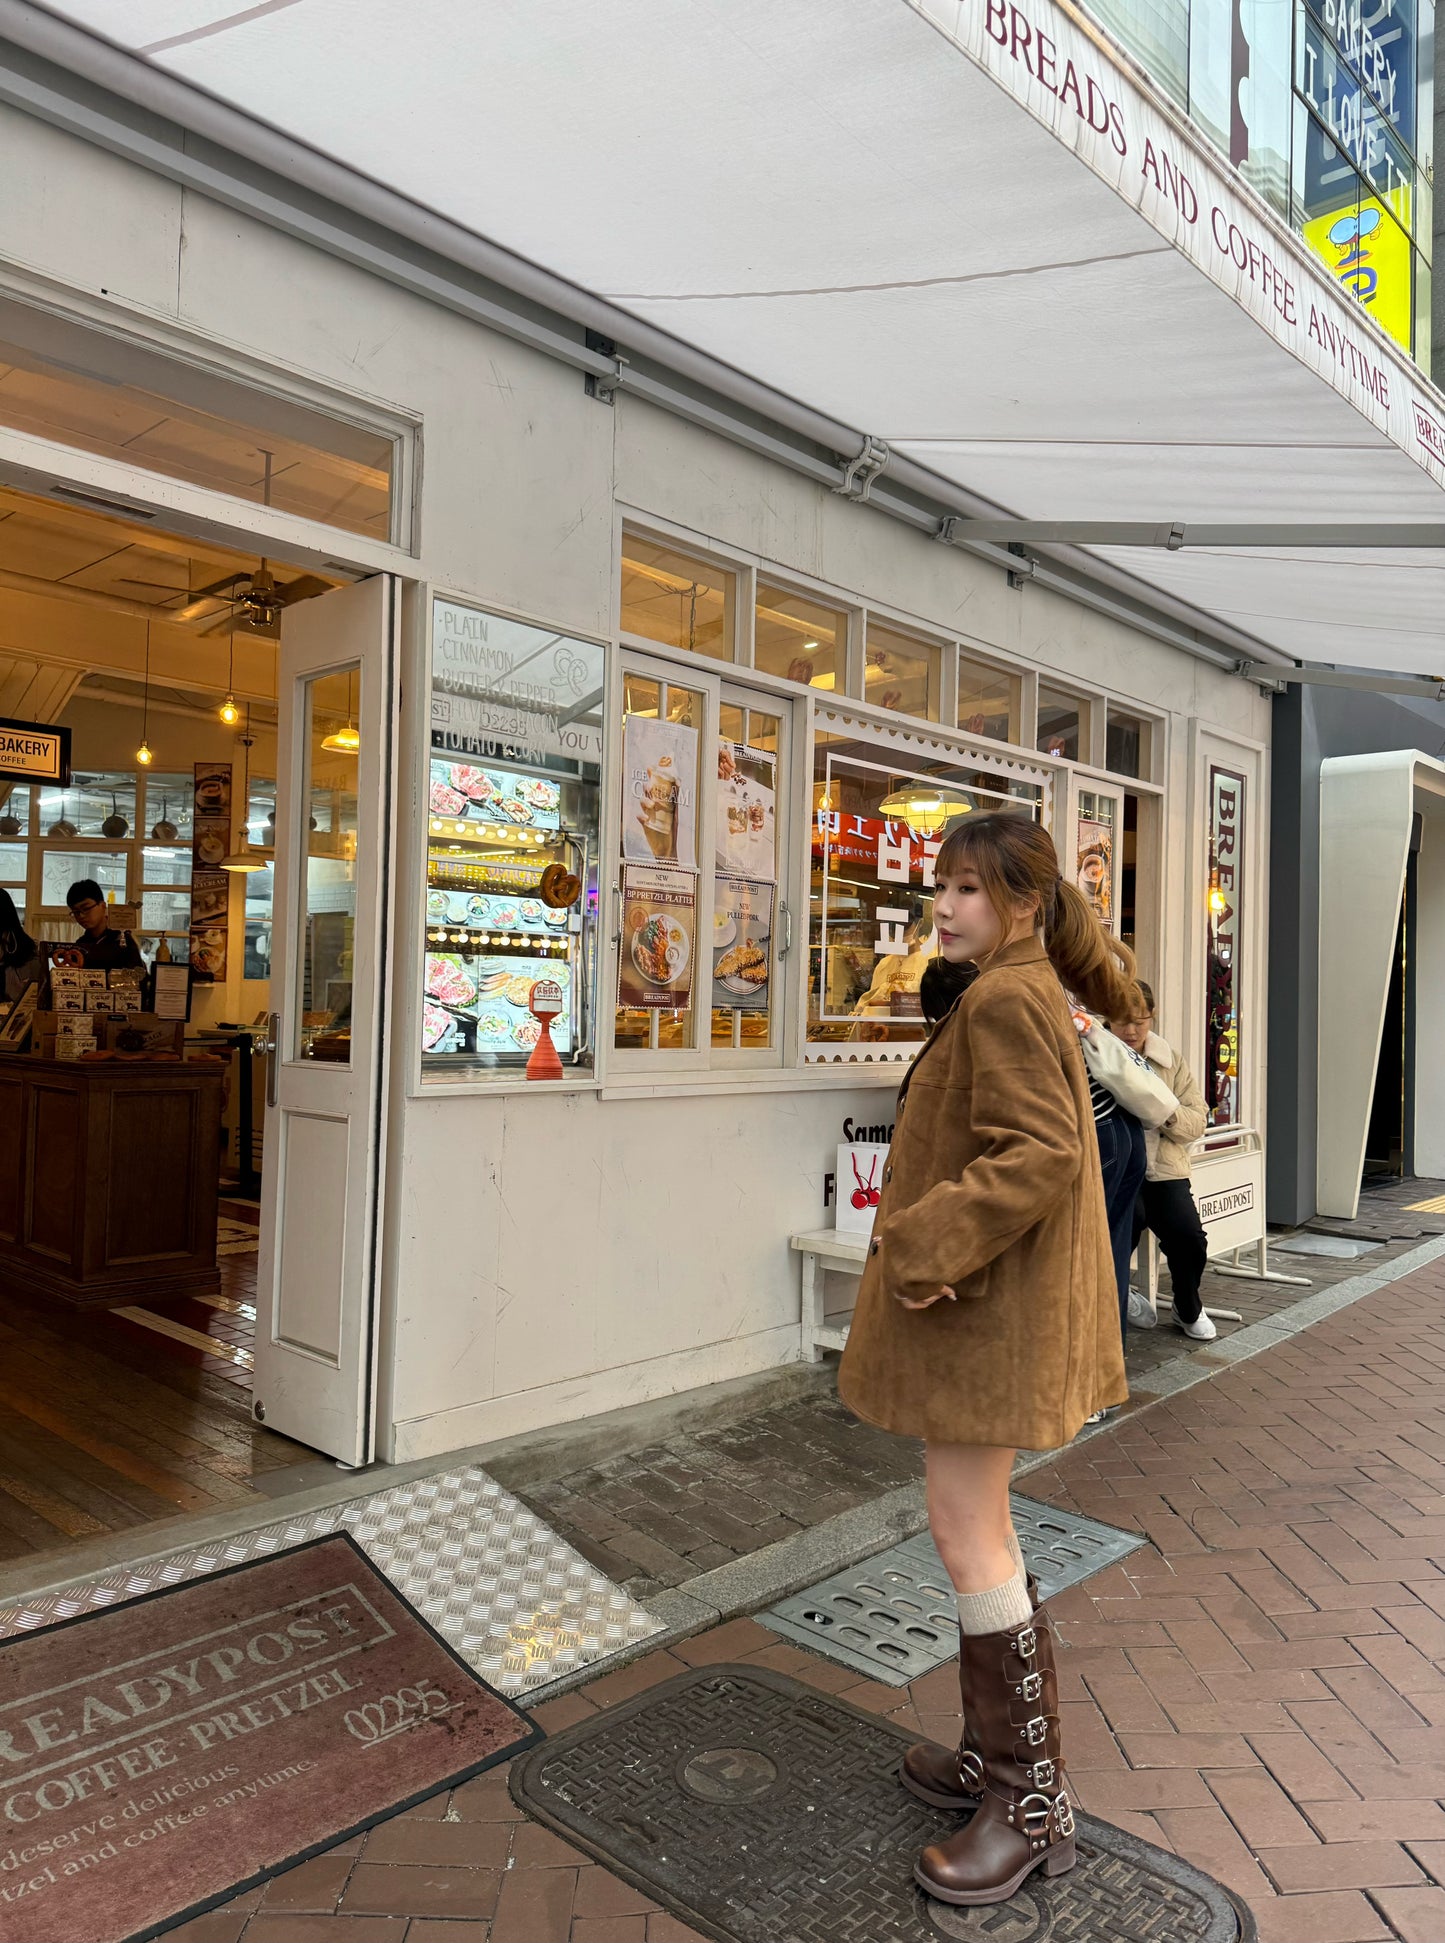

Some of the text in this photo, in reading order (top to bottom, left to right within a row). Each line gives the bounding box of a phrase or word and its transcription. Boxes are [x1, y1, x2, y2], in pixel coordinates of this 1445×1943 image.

[1328, 74, 1377, 188] LOVE
[985, 0, 1390, 411] BREADS AND COFFEE ANYTIME
[444, 611, 488, 641] PLAIN
[443, 638, 514, 672] CINNAMON
[0, 736, 50, 757] BAKERY
[558, 729, 590, 750] YOU
[631, 768, 649, 781] ICE
[636, 890, 665, 902] PRETZEL
[1201, 1190, 1252, 1218] BREADYPOST
[343, 1678, 452, 1743] 02295
[3, 1667, 364, 1824] COFFEE PRETZEL
[0, 1762, 241, 1872] deserve delicious
[63, 1841, 121, 1877] and
[123, 1803, 210, 1849] coffee
